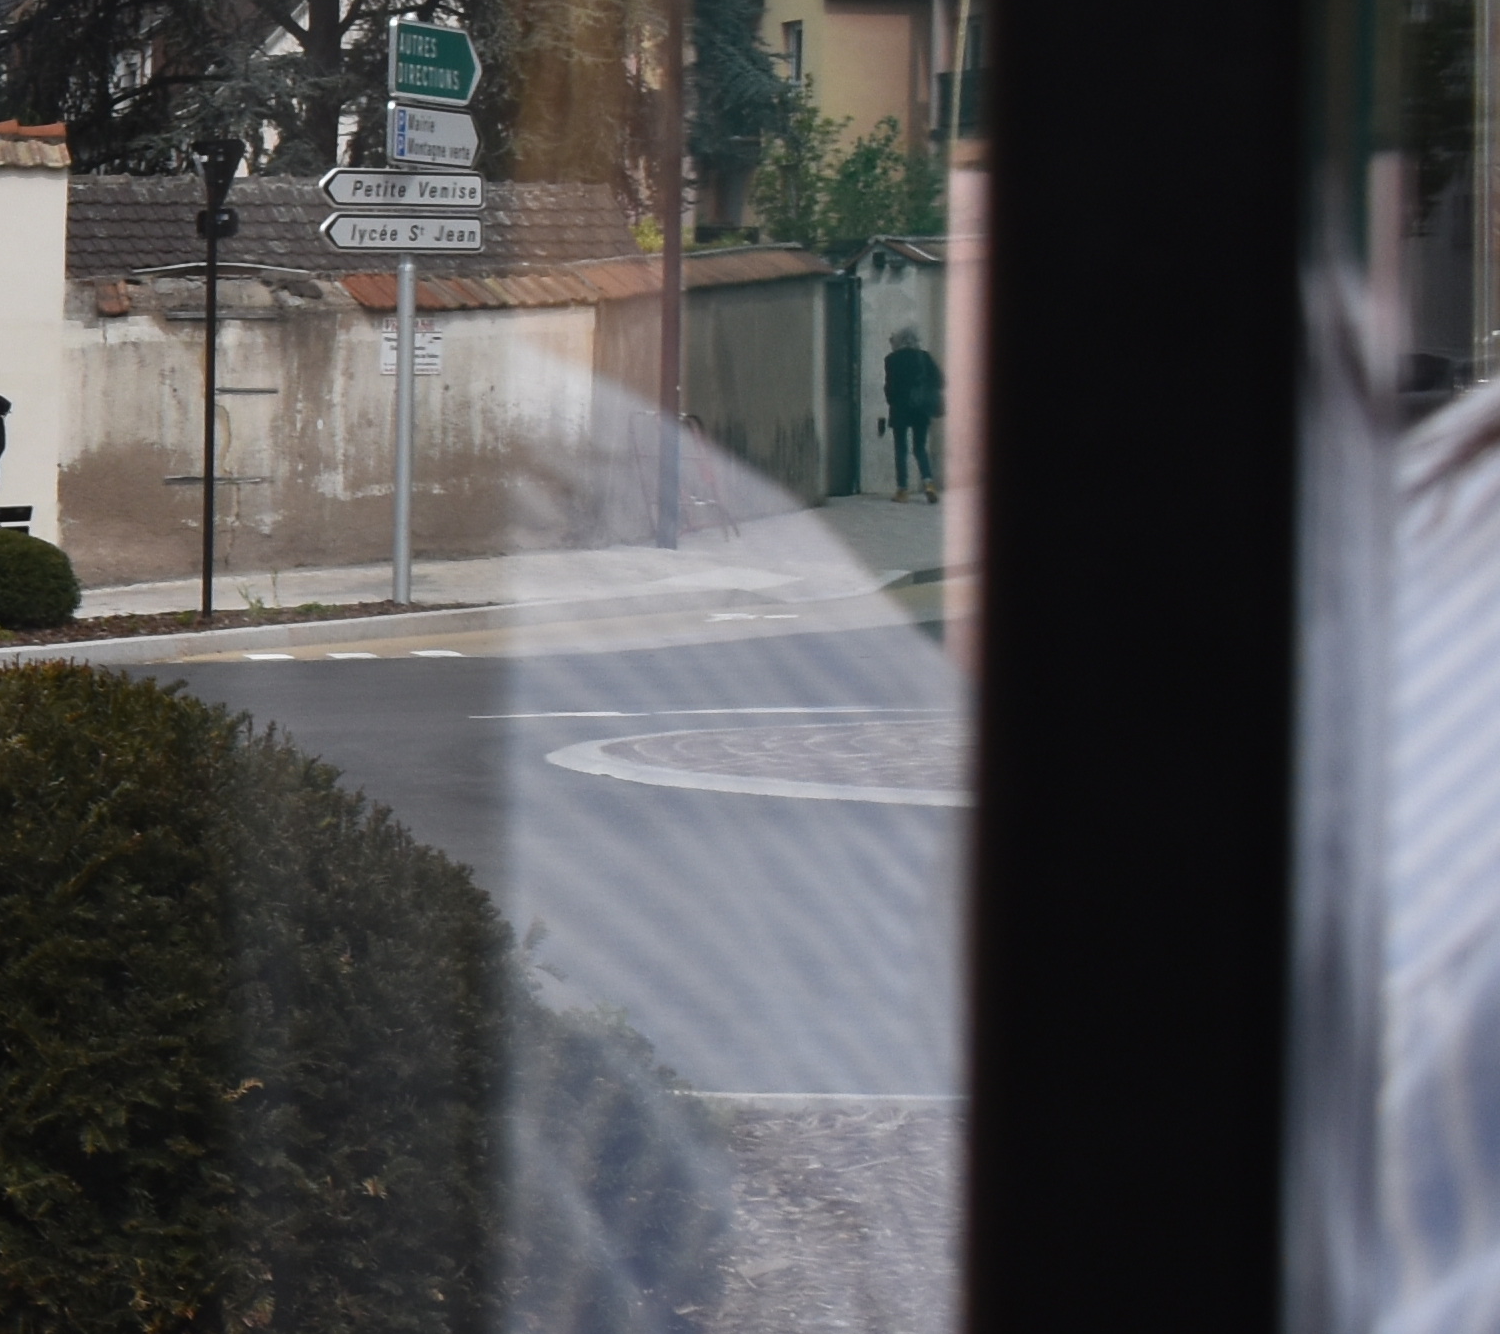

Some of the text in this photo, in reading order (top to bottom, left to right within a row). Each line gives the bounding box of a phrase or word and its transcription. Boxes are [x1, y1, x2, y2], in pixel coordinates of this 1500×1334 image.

[400, 32, 437, 59] AUTRES
[397, 62, 460, 91] DIRECTIONS
[352, 180, 477, 200] Petite Venise
[350, 224, 398, 245] lycée
[434, 225, 476, 243] Jean
